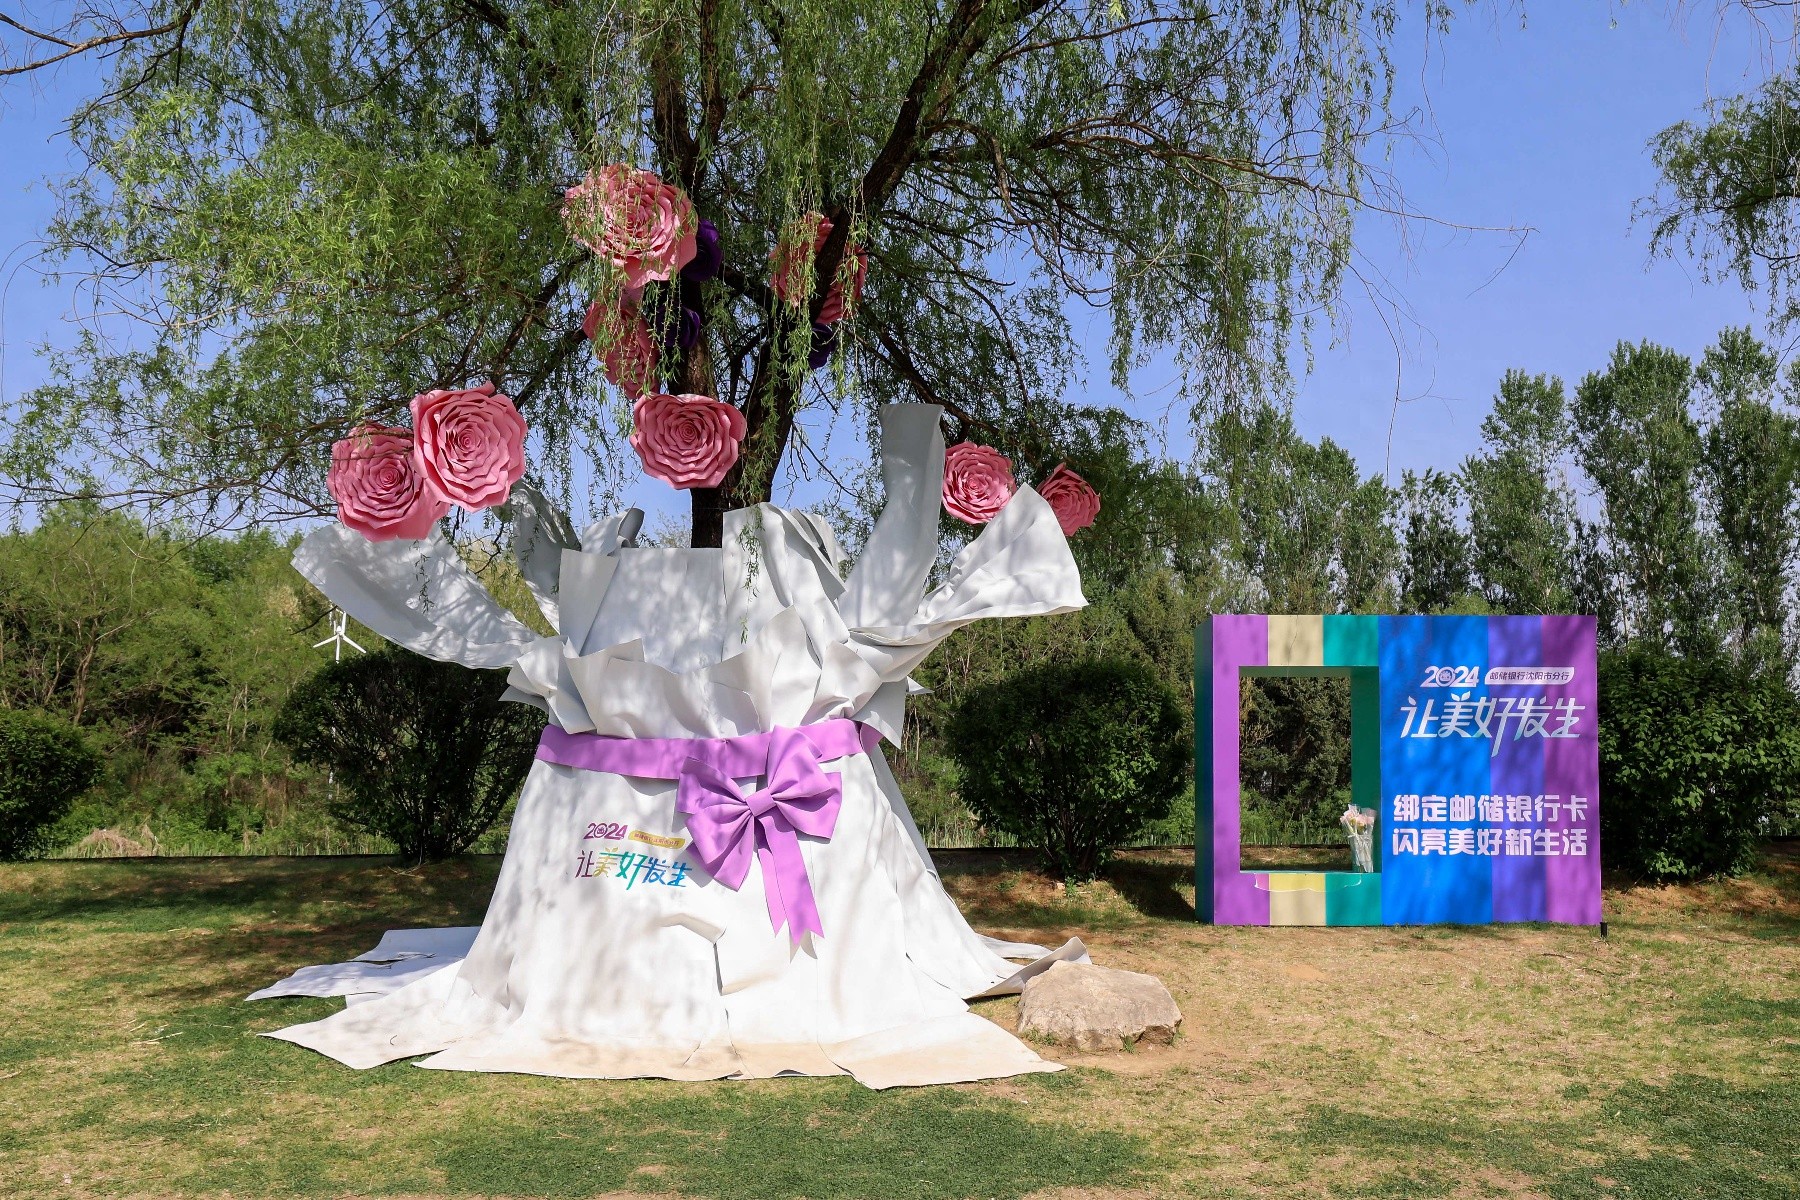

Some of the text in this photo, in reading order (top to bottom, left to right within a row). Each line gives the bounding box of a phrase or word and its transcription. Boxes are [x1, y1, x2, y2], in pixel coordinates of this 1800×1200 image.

[1420, 666, 1480, 688] 2024
[1489, 671, 1570, 681] 邮储银行沈阳市分行
[1400, 691, 1586, 758] 让美好发生
[1393, 794, 1588, 822] 绑定邮储银行卡
[583, 822, 628, 840] 2024
[1392, 828, 1588, 856] 闪亮美好新生活
[575, 847, 692, 890] 让美好发生
